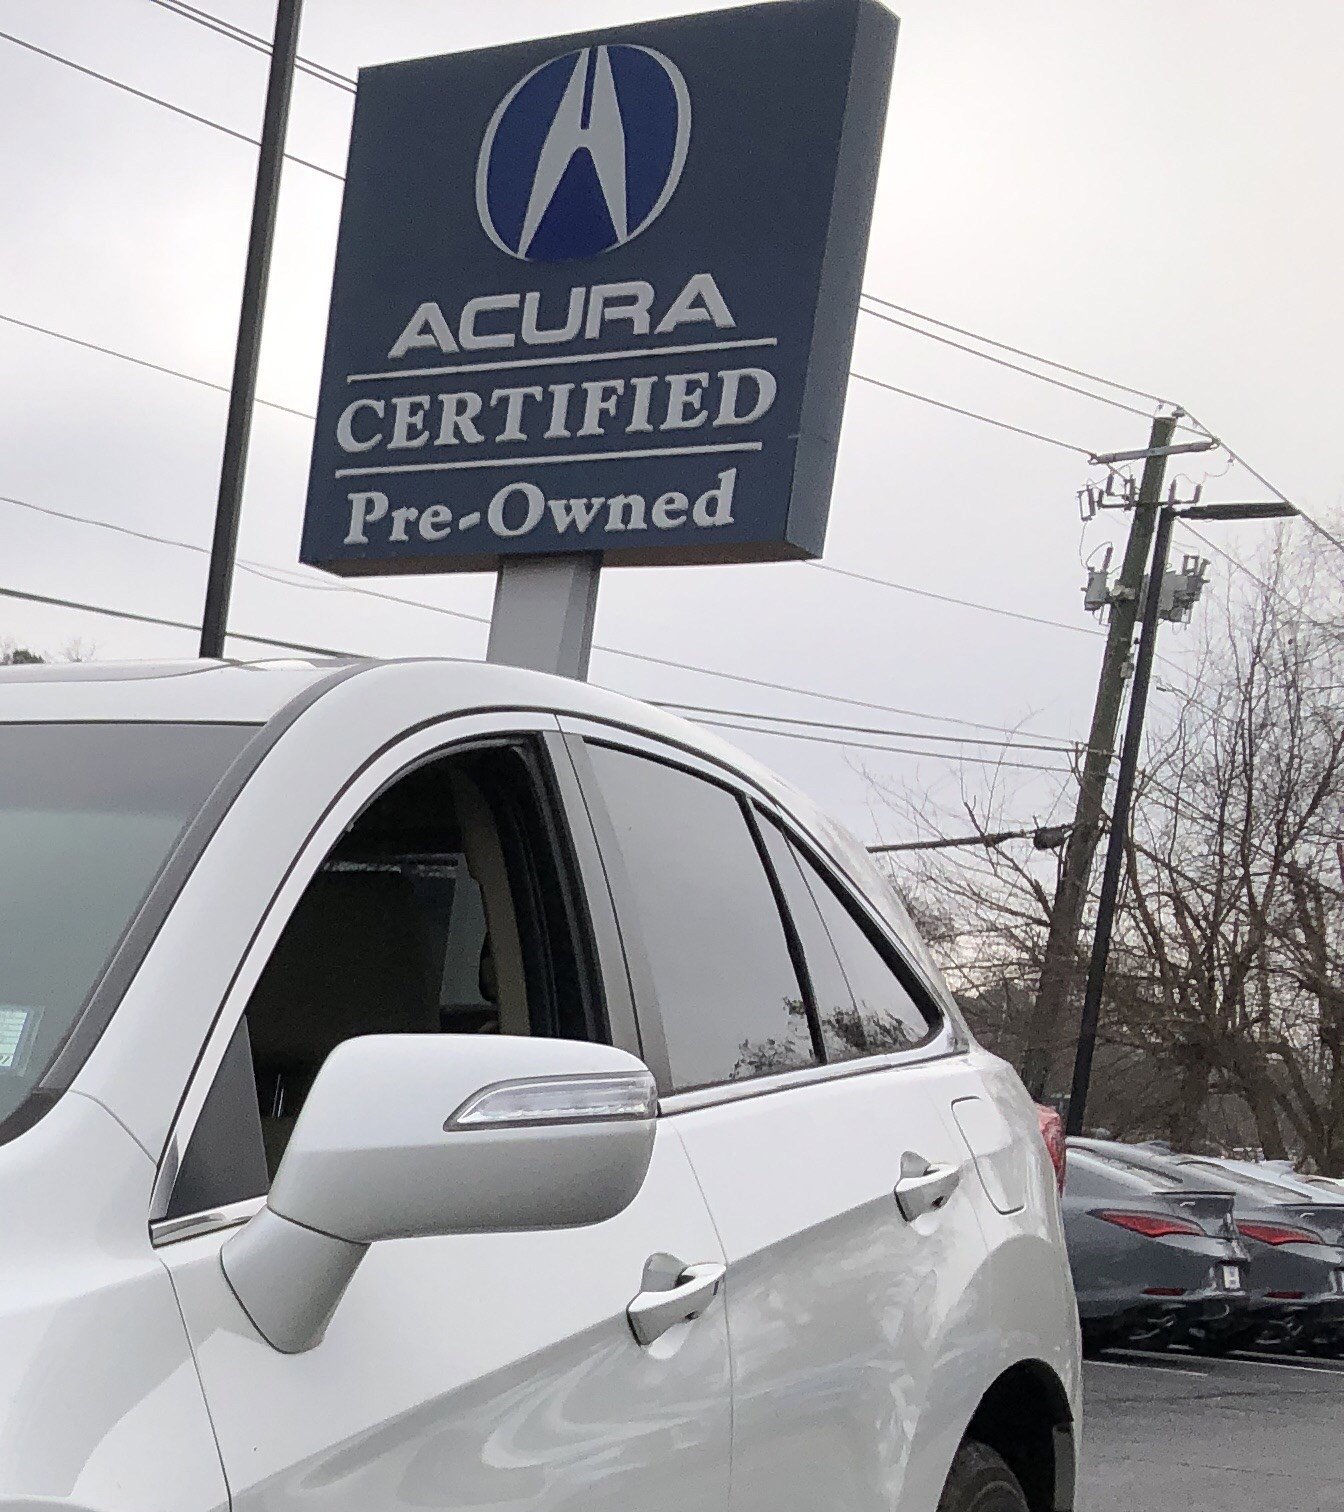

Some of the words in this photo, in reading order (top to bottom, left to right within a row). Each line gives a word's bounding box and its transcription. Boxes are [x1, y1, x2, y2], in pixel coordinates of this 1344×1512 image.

[387, 273, 737, 360] ACURA
[335, 366, 778, 453] CERTIFIED
[342, 466, 738, 546] Pre-Owned
